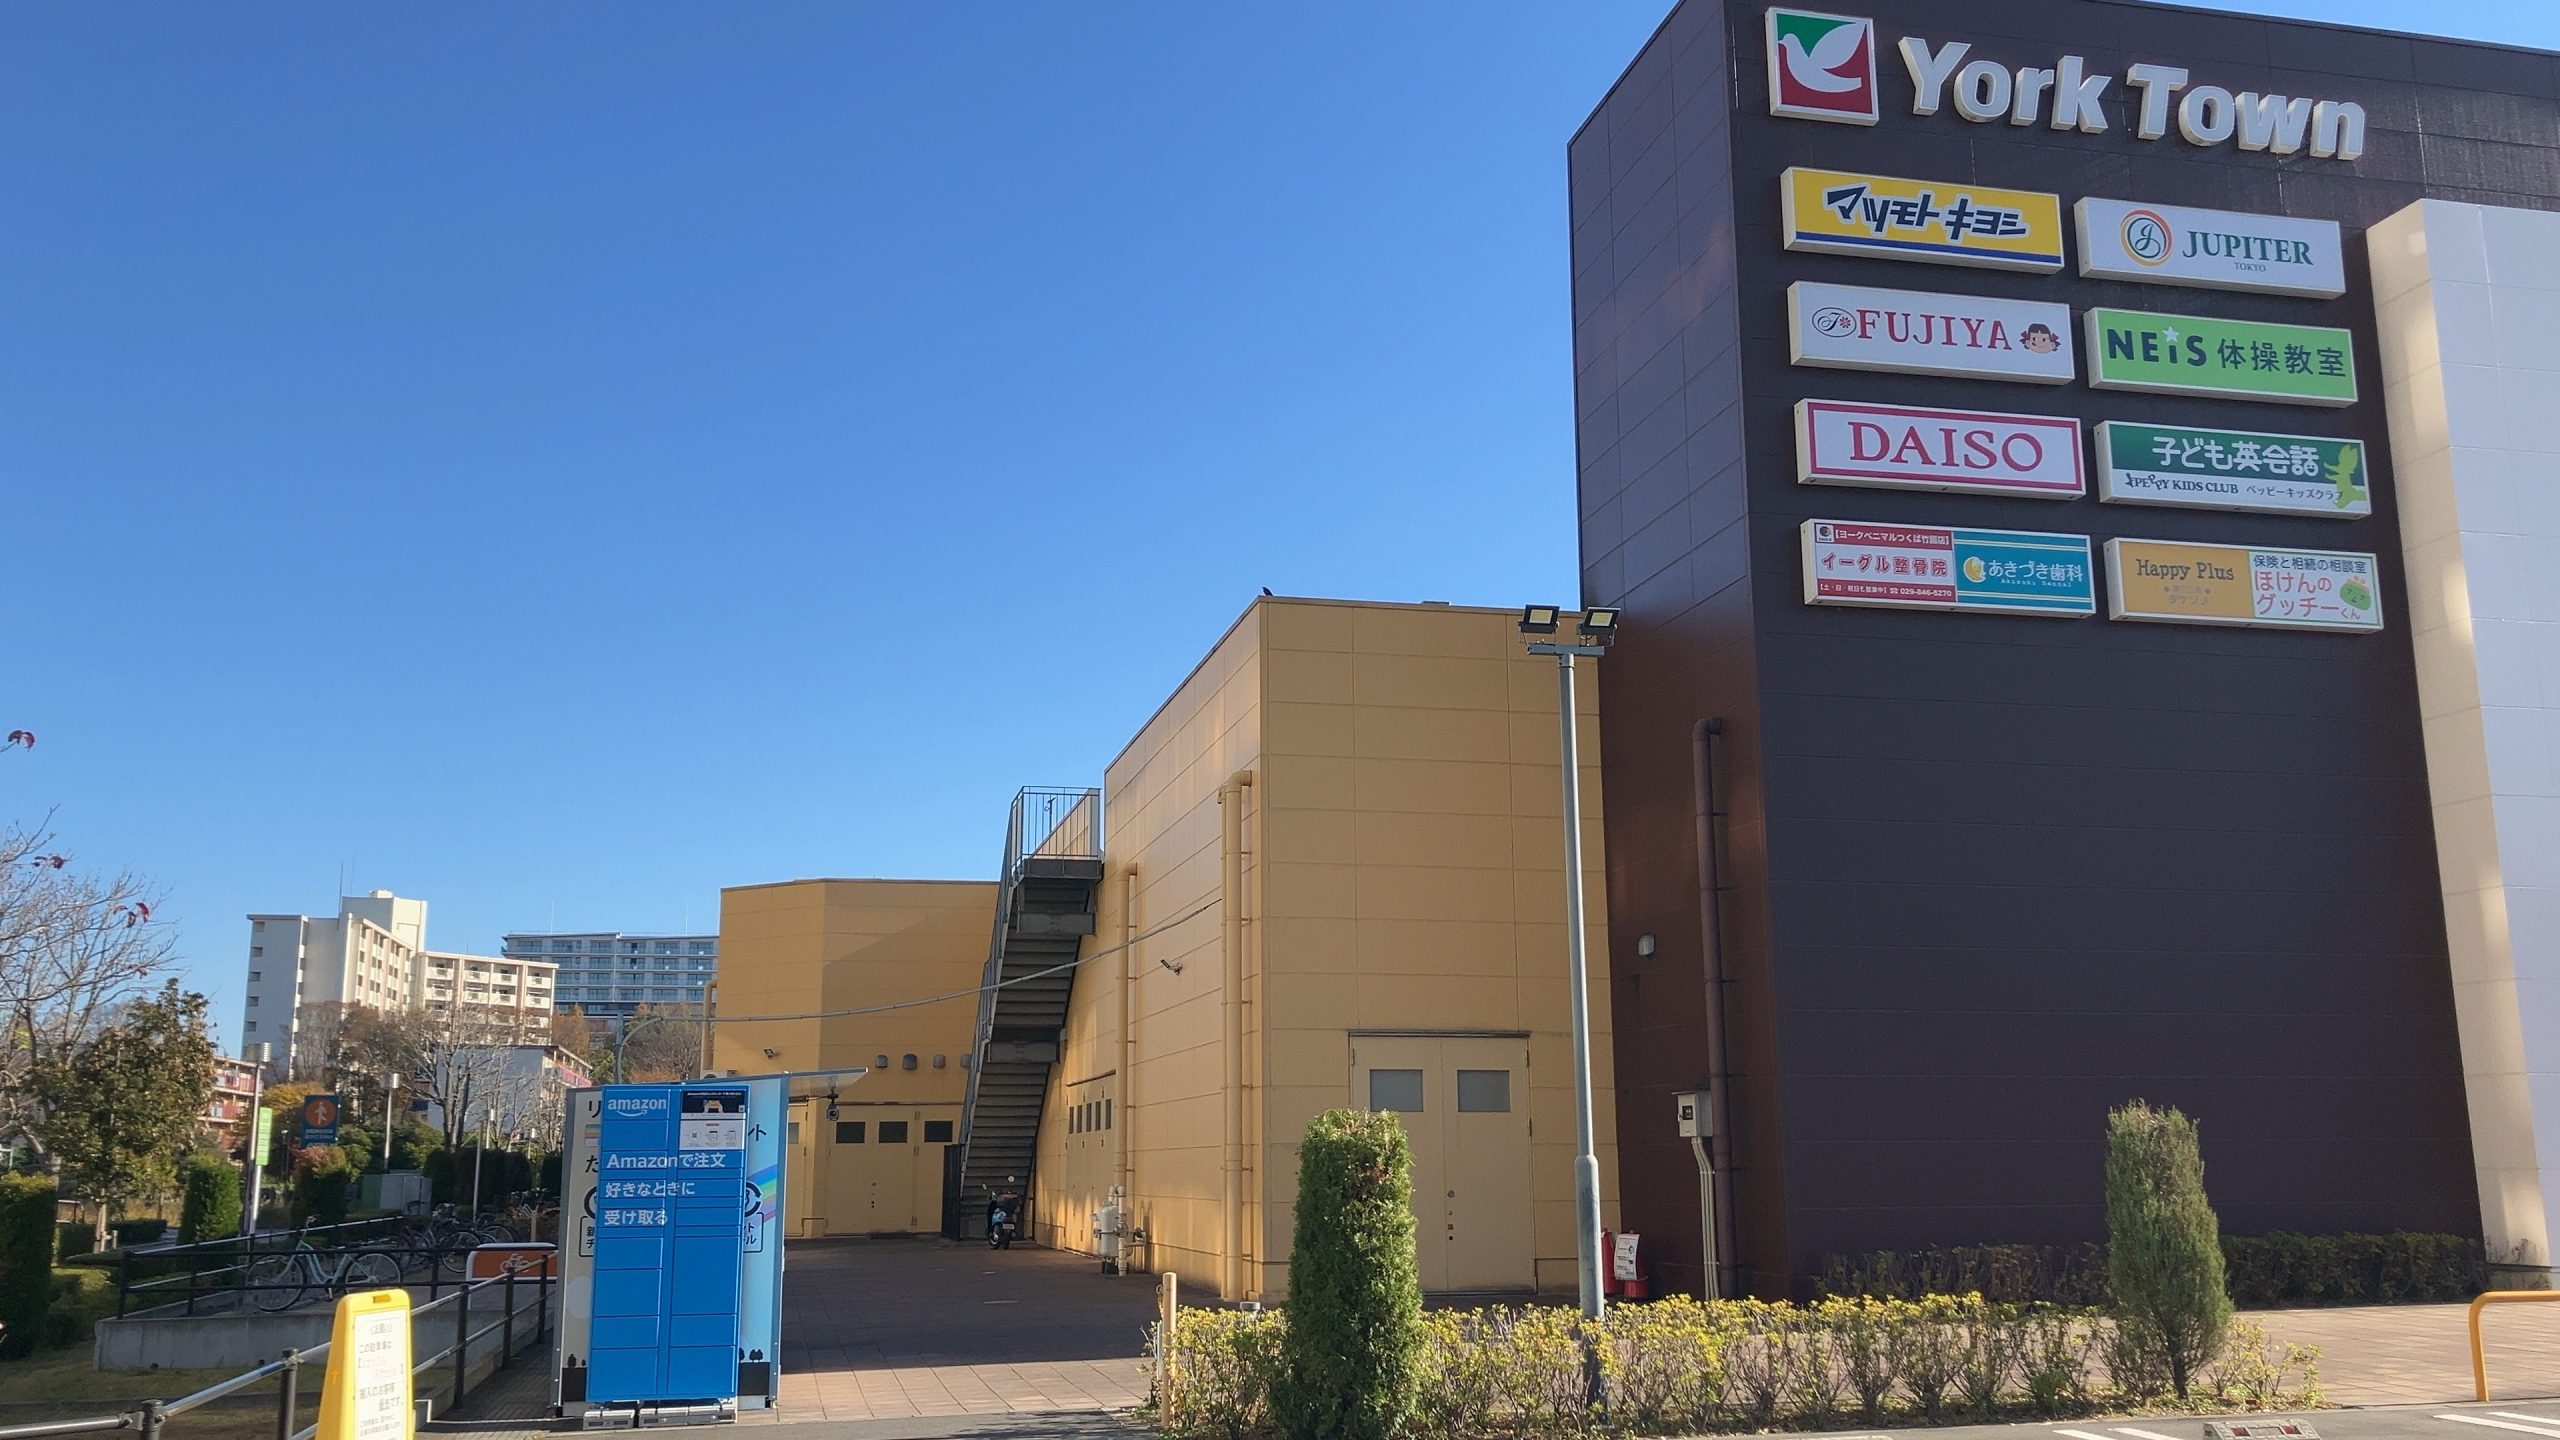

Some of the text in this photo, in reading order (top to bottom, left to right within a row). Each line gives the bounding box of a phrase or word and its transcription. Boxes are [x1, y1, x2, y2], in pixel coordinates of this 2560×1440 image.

[1899, 37, 2366, 160] York Town
[1825, 185, 2027, 241] マツモトキヨシ
[2183, 231, 2314, 265] JUPITER
[2234, 262, 2266, 272] TOKYO
[1856, 309, 2012, 350] FUJIYA
[2217, 338, 2346, 377] 体操教室
[1848, 421, 2043, 472] DAISO
[2152, 436, 2319, 477] 子ども英会話
[2172, 480, 2203, 491] KIDS
[2205, 483, 2239, 494] CLUB
[1822, 552, 1949, 576] イーグル整骨院
[1988, 560, 2084, 582] あきづき歯科
[2136, 558, 2234, 580] Happy Plus
[2254, 570, 2332, 593] ほけんの
[607, 1098, 667, 1111] amazon
[606, 1152, 726, 1168] Amazonで注文
[605, 1182, 695, 1198] 好きなときに
[604, 1210, 668, 1226] 受け取る
